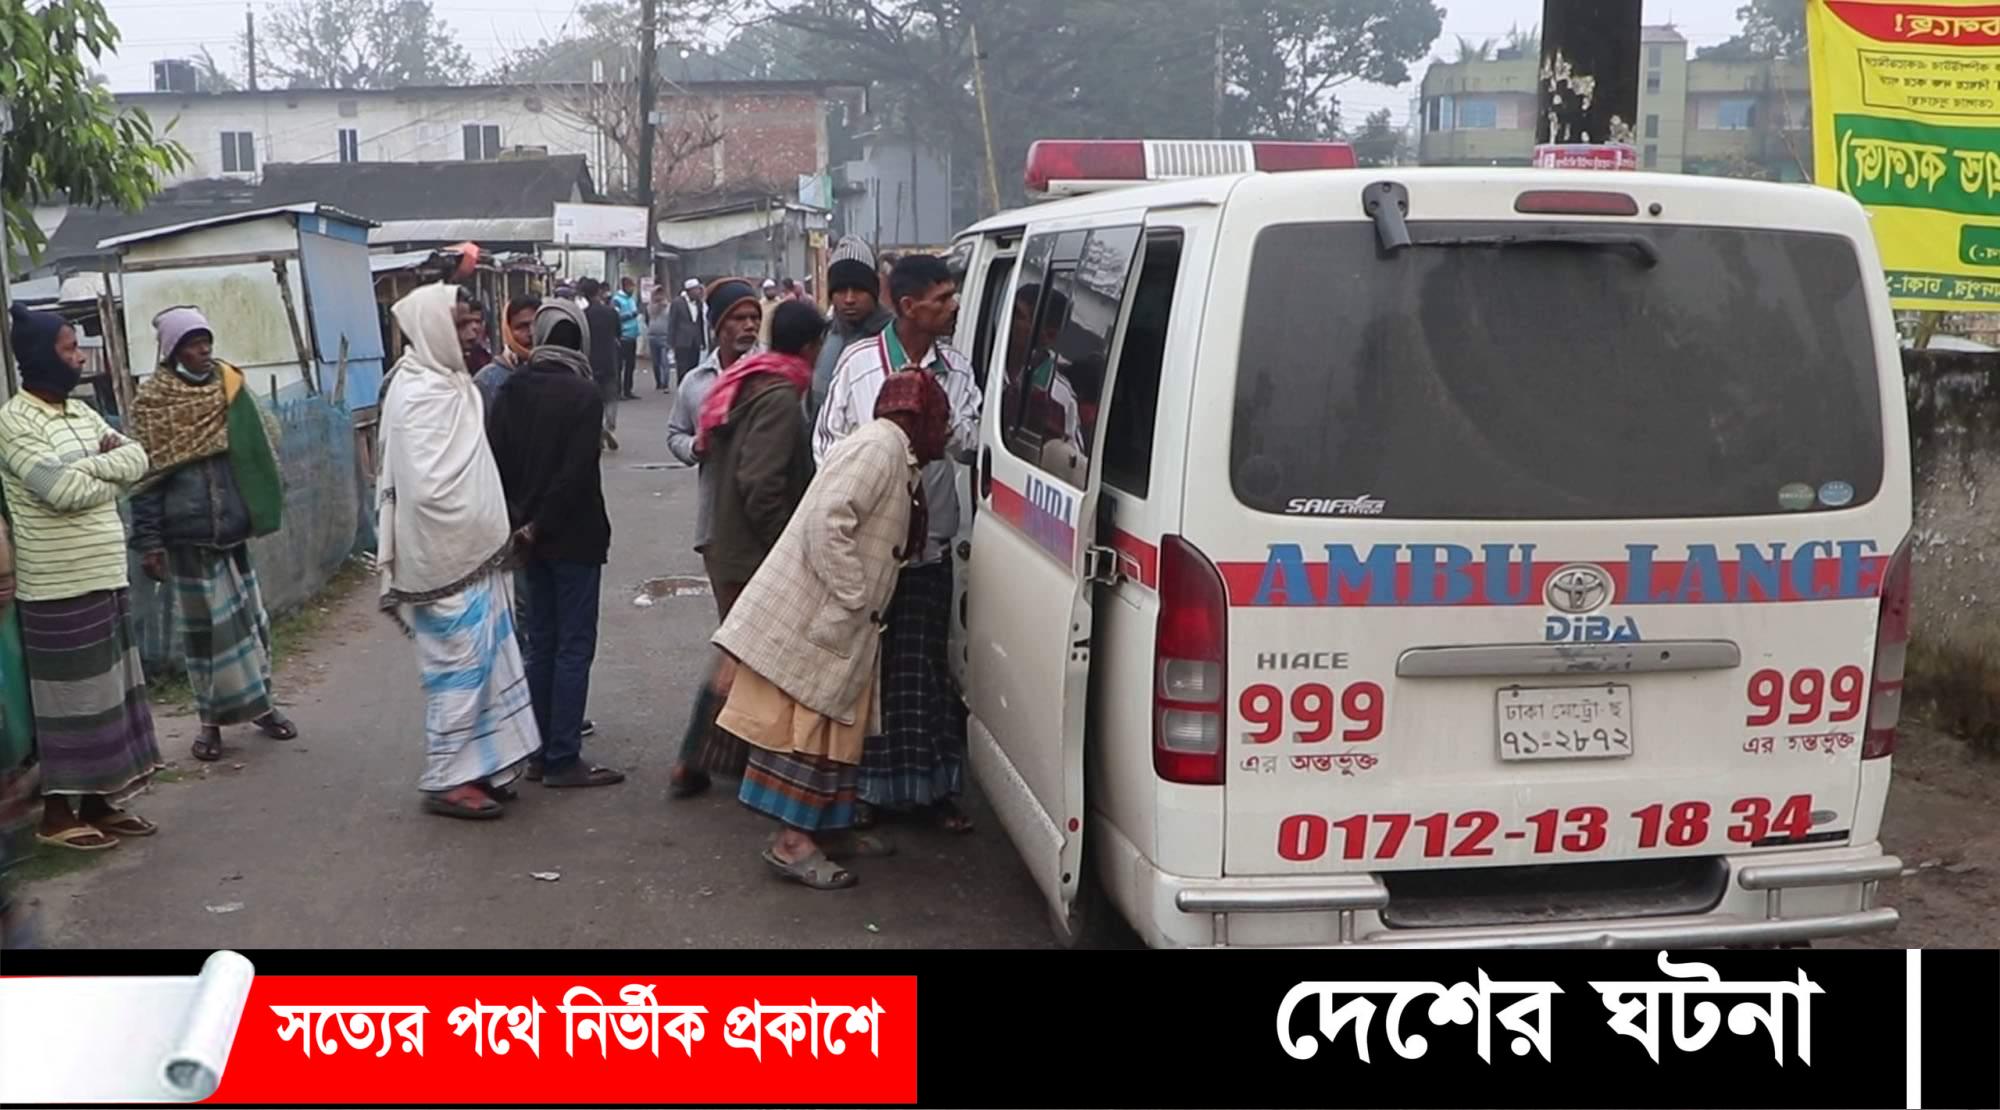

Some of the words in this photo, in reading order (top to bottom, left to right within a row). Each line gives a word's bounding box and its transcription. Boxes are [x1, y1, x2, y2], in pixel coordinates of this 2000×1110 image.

[1257, 652, 1349, 670] HIACE
[1239, 681, 1385, 744] 999
[1505, 704, 1544, 720] ঢাকা
[1746, 665, 1864, 727] 999
[1631, 801, 1712, 849] 18
[1727, 793, 1813, 843] 34
